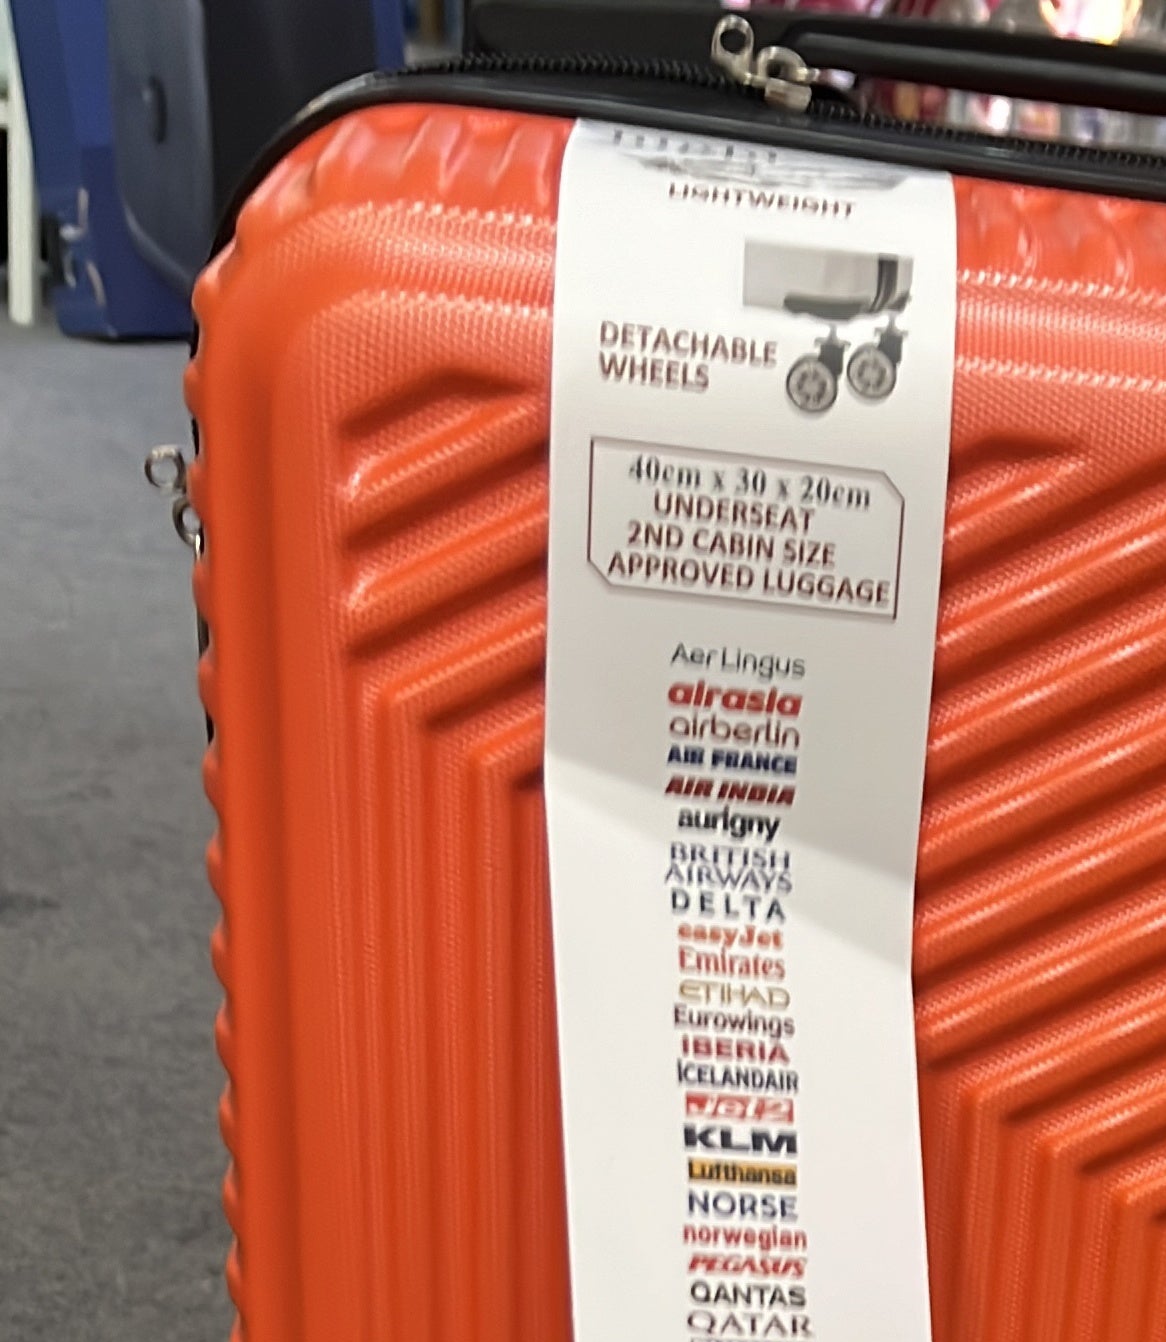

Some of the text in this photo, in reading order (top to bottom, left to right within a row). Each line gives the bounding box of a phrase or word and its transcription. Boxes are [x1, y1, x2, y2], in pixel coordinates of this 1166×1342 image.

[599, 320, 778, 369] DETACHABLE
[599, 352, 710, 393] WHEELS
[628, 453, 872, 511] 40cm x 30 x 20cm
[653, 490, 815, 532] UNDERSEAT
[627, 520, 836, 568] 2ND CABIN SIZE
[607, 551, 891, 606] APPROVED LUGGAGE
[671, 642, 806, 682] Aer Lingus
[668, 678, 803, 718] airasia
[669, 712, 801, 749] airberlin
[667, 743, 798, 775] AIR FRANCE
[665, 774, 796, 807] AIR INDIA
[678, 804, 780, 842] aurigny
[670, 841, 790, 870] BRITISH
[665, 862, 792, 894] AIRWAYS
[671, 887, 785, 923] DELTA
[678, 922, 782, 950] easyJet
[678, 944, 785, 982] Emirates
[679, 978, 791, 1012] ETIHAD
[674, 1001, 795, 1040] Eurowings
[682, 1034, 790, 1065] IBERIA
[677, 1057, 799, 1093] ICELANDAIR
[683, 1122, 798, 1156] KLM
[687, 1158, 796, 1186] Lufthansa
[687, 1188, 798, 1222] NORSE
[683, 1223, 808, 1252] norwegian
[688, 1251, 808, 1280] PEGASUS
[689, 1279, 807, 1308] QANTAS
[687, 1310, 814, 1339] QATAR
